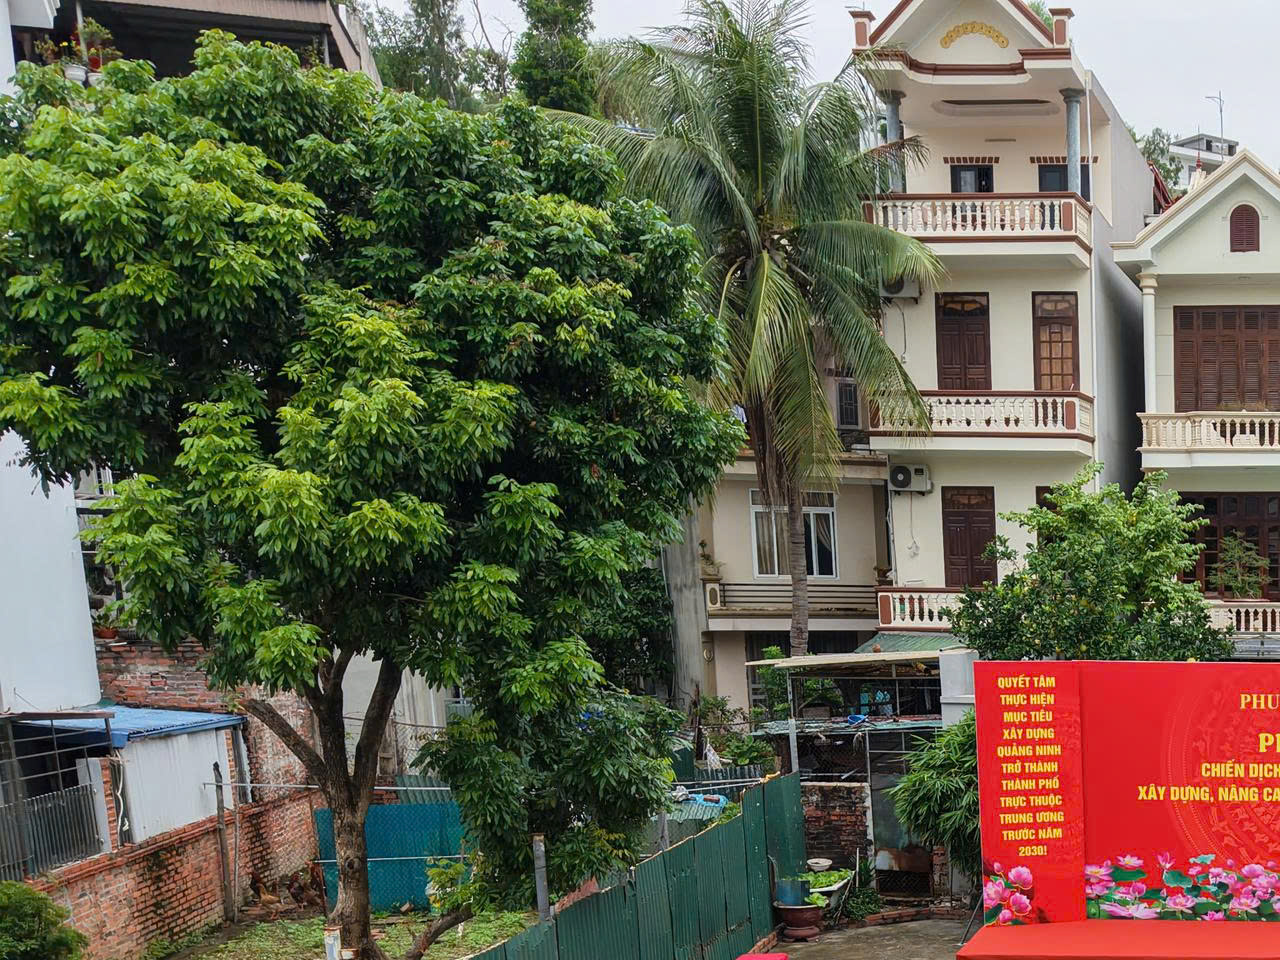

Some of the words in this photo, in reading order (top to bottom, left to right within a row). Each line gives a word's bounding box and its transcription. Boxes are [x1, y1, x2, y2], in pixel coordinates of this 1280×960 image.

[997, 674, 1031, 689] QUYẾT
[1032, 674, 1056, 688] TÂM
[1000, 693, 1027, 708] THỰC
[1030, 692, 1055, 707] HIỆN
[1003, 711, 1028, 725] MỤC
[1030, 709, 1053, 722] TIÊU
[1003, 726, 1023, 740] XÂY
[1026, 728, 1055, 741] DỰNG
[997, 742, 1033, 758] QUẢNG
[1035, 745, 1062, 756] NINH
[1001, 760, 1022, 774] TRỞ
[1024, 760, 1058, 773] THÀNH
[1201, 759, 1245, 778] CHIẾN
[1001, 778, 1036, 791] THÀNH
[1038, 775, 1060, 789] PHỐ
[1000, 795, 1027, 809] TRỰC
[1029, 793, 1063, 808] THUỘC
[1138, 783, 1165, 800] XÂY
[1170, 785, 1214, 804] DỰNG,
[1218, 783, 1259, 801] NÂNG
[999, 812, 1034, 824] TRUNG
[1035, 811, 1064, 822] ƯƠNG
[1002, 827, 1035, 841] TRƯỚC
[1038, 826, 1063, 839] NĂM
[1018, 845, 1048, 856] 2030!
